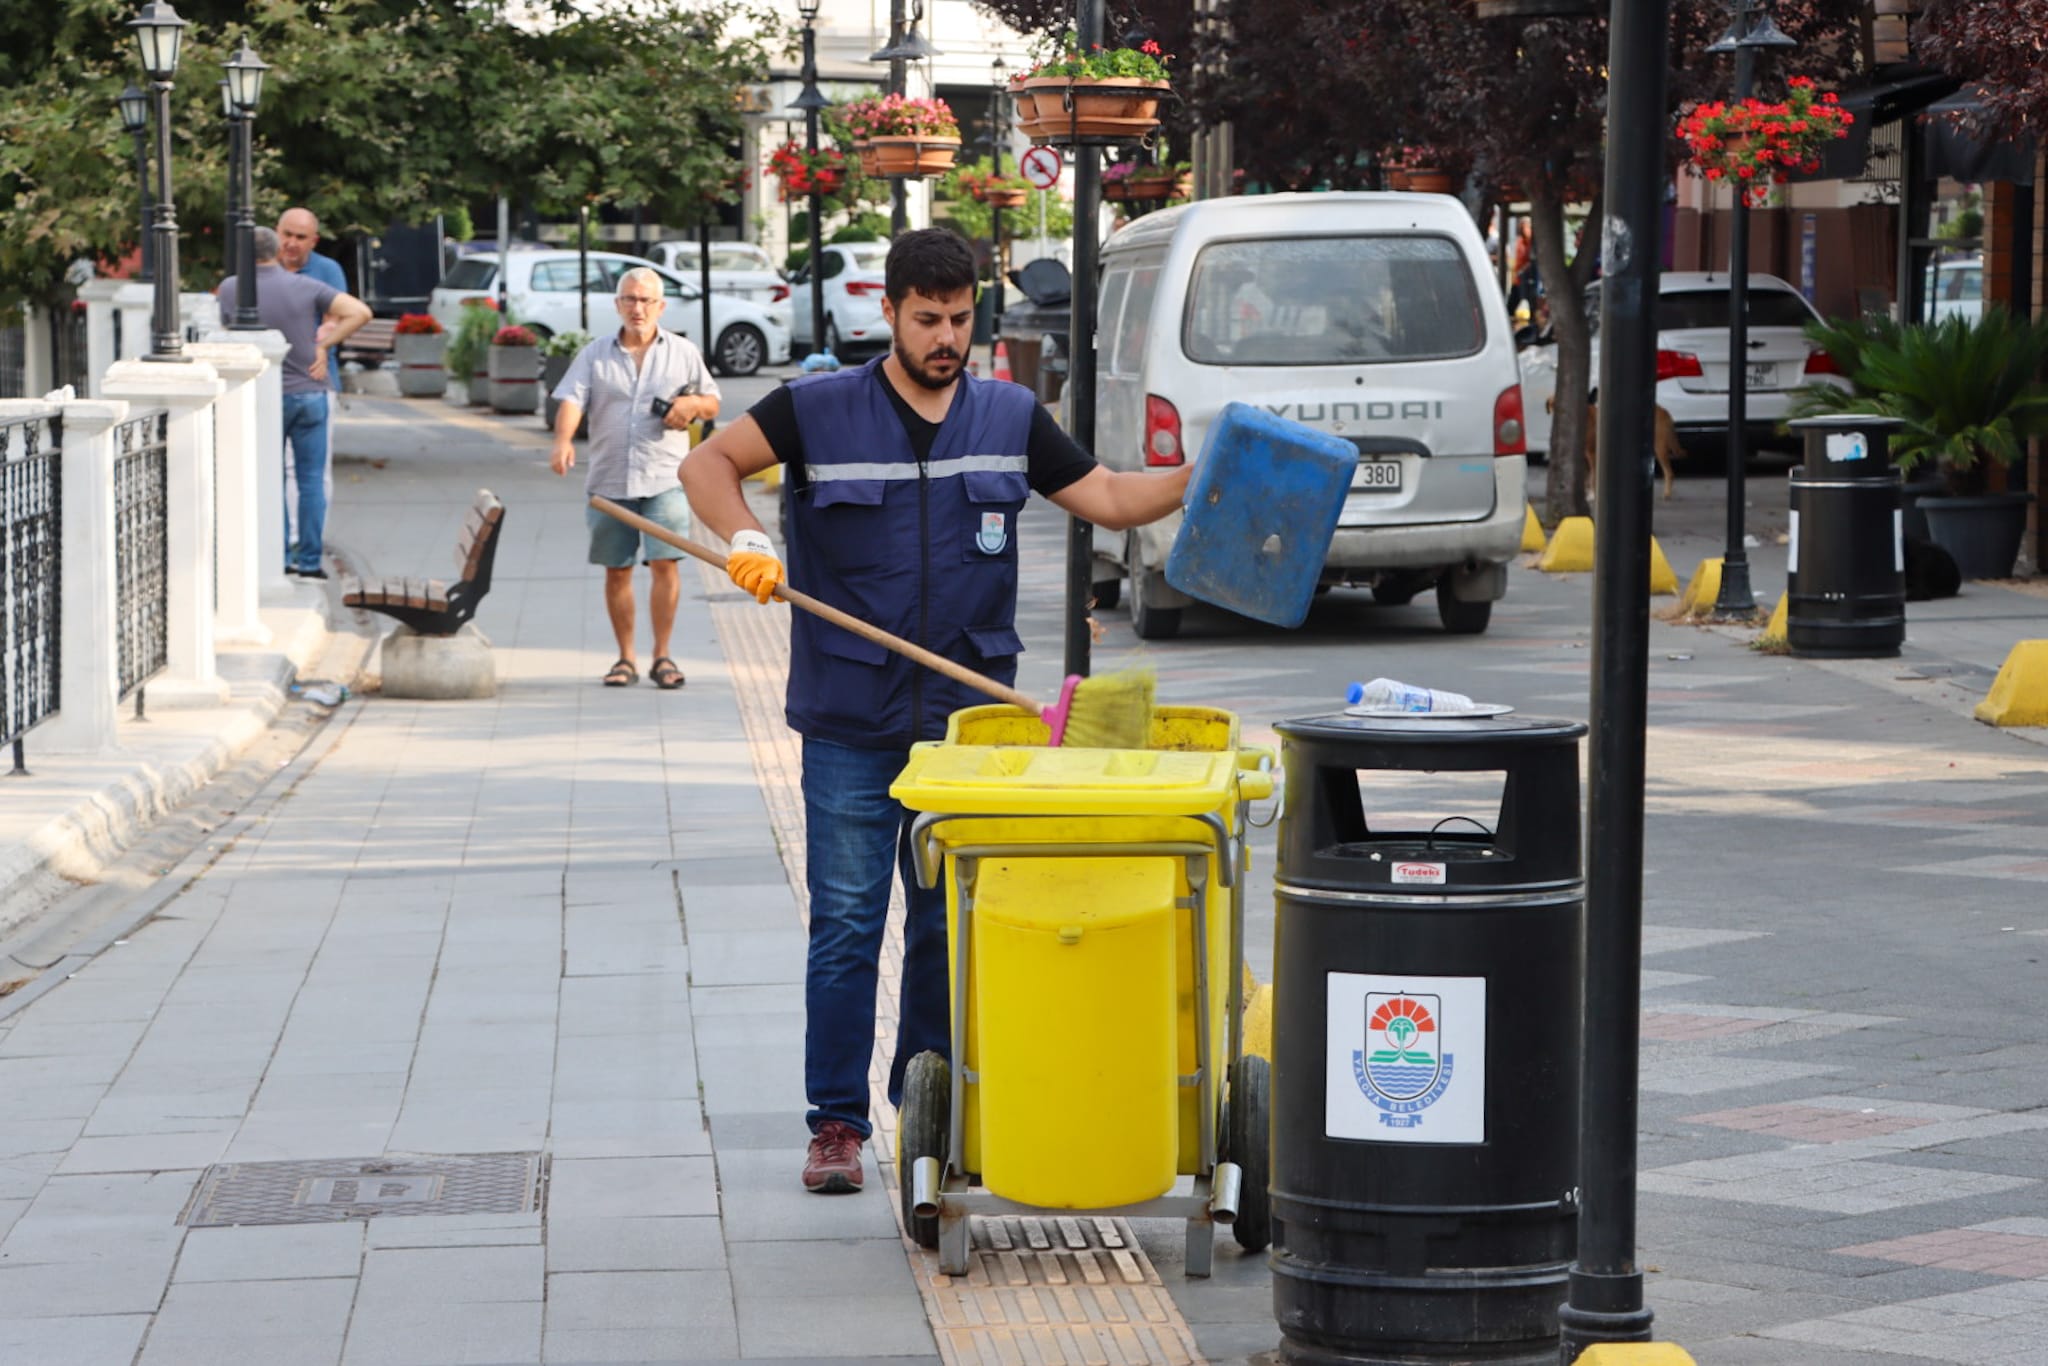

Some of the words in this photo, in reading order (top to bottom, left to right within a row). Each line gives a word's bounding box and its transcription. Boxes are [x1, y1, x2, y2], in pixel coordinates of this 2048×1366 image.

[1253, 401, 1443, 422] YUNDAI
[1364, 465, 1396, 485] 380
[1353, 1059, 1381, 1104] YALOVA
